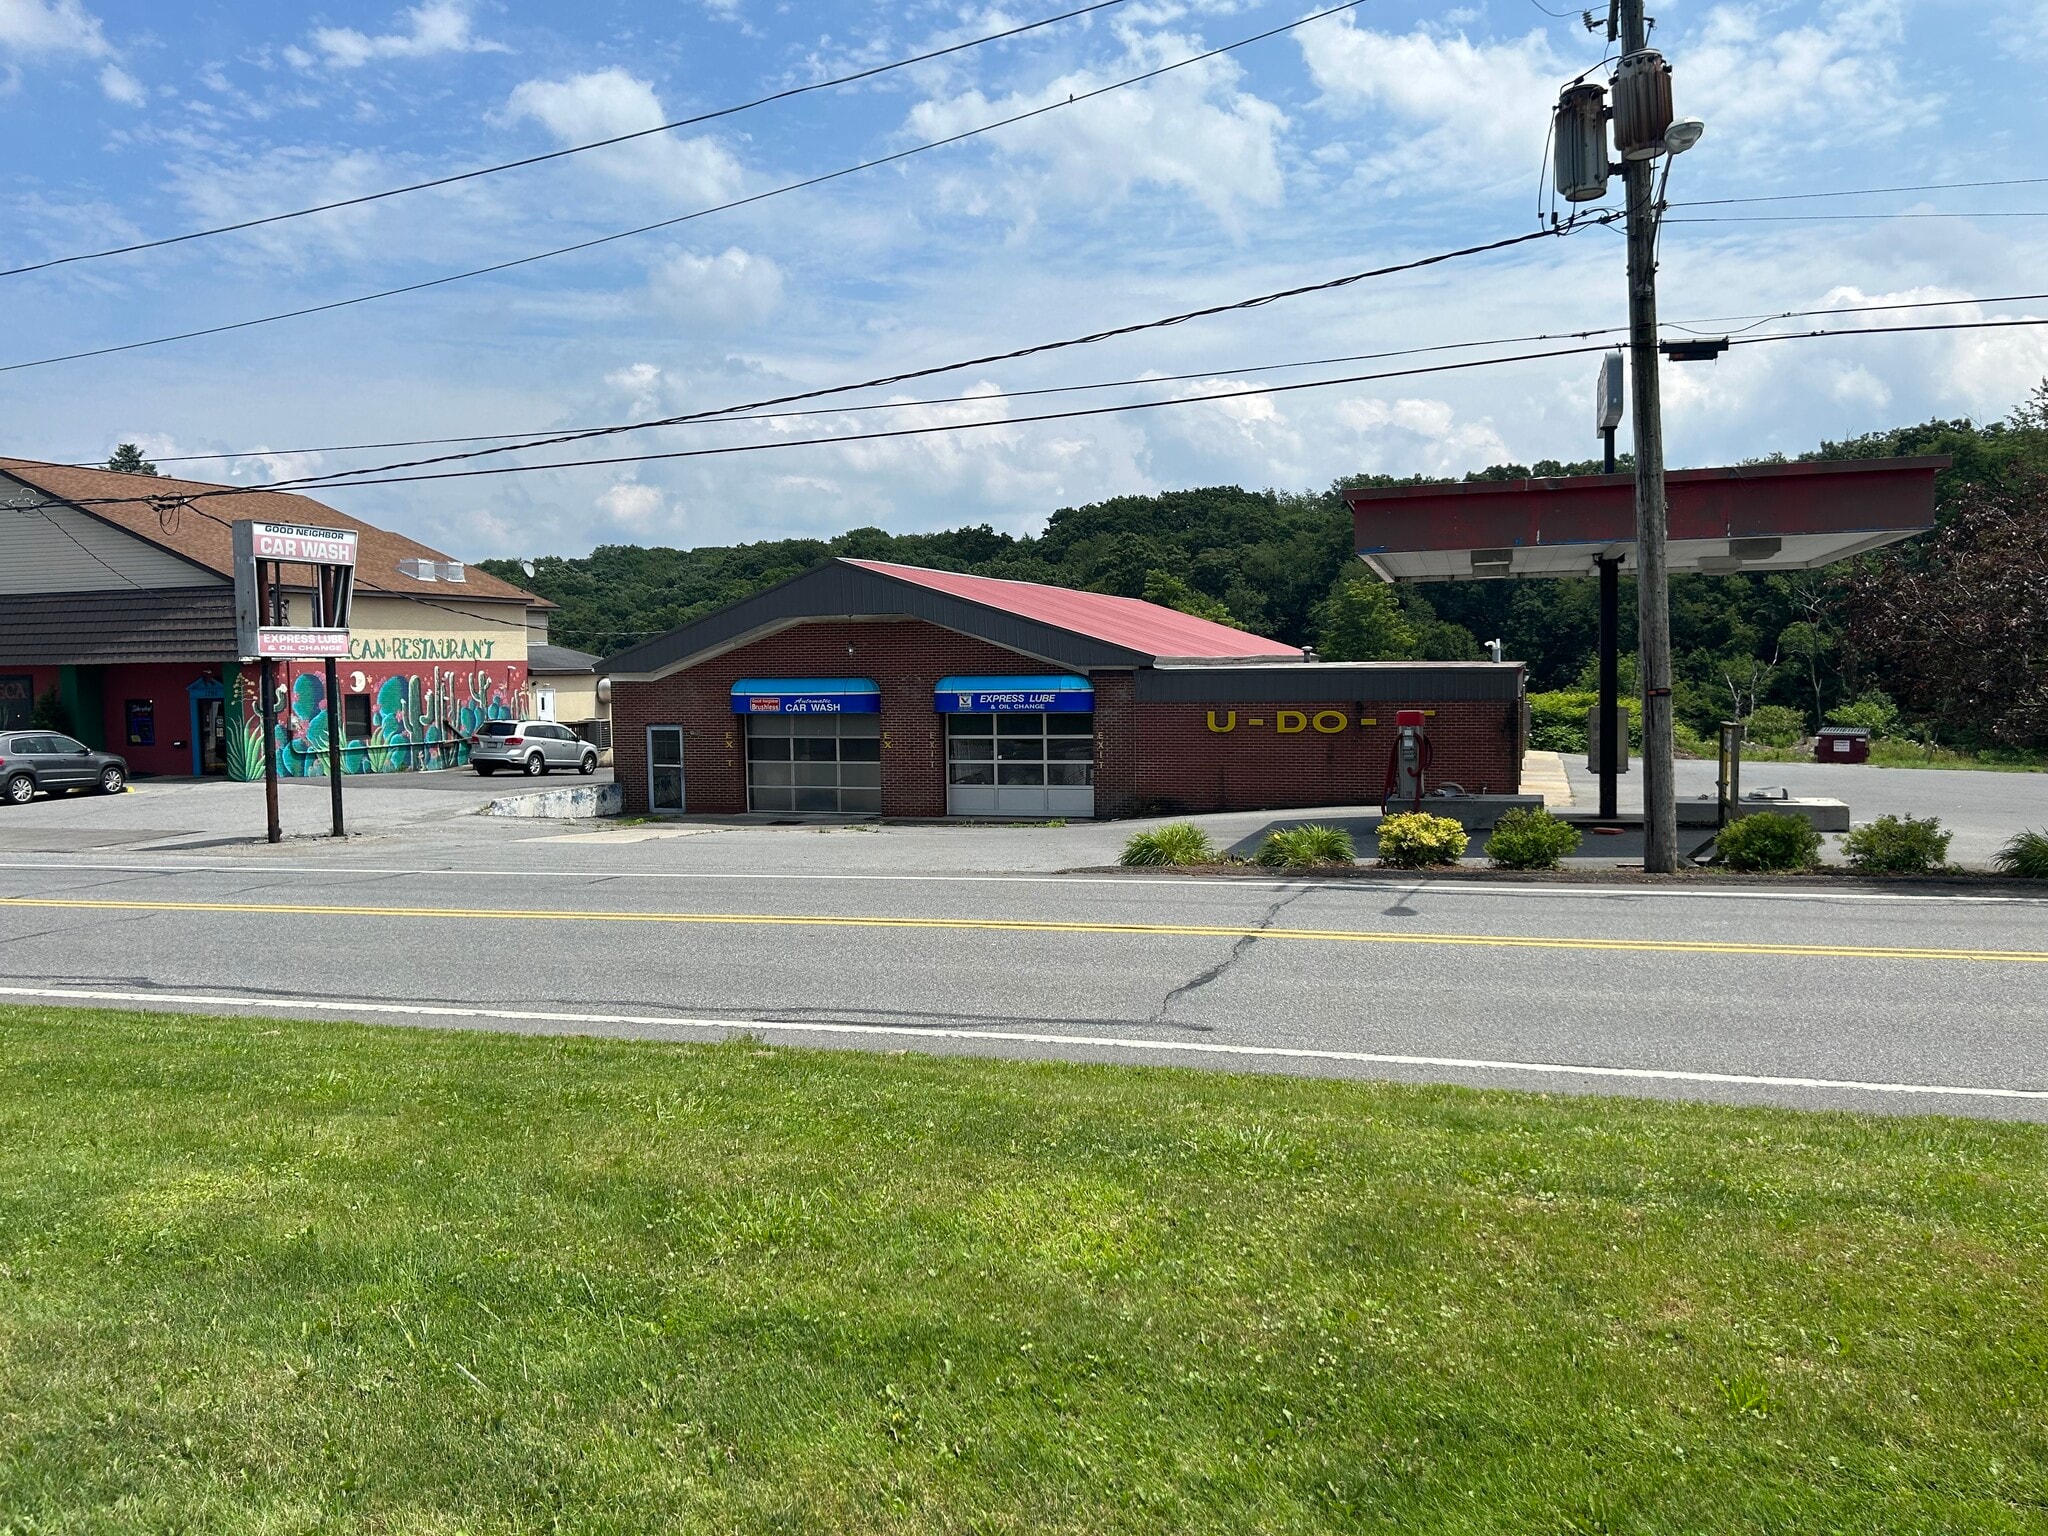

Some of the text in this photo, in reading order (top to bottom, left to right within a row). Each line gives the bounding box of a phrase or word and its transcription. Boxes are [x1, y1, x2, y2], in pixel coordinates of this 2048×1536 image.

[265, 525, 344, 540] GOOD NEIGHBOR
[260, 537, 350, 560] CAR WASH
[263, 633, 345, 644] EXPRESS LUBE
[346, 637, 495, 660] CAN RESTAURANT
[979, 694, 1025, 703] EXPRESS
[1029, 694, 1056, 703] LUBE
[752, 703, 779, 711] Brushless
[785, 703, 841, 712] CAR WASH
